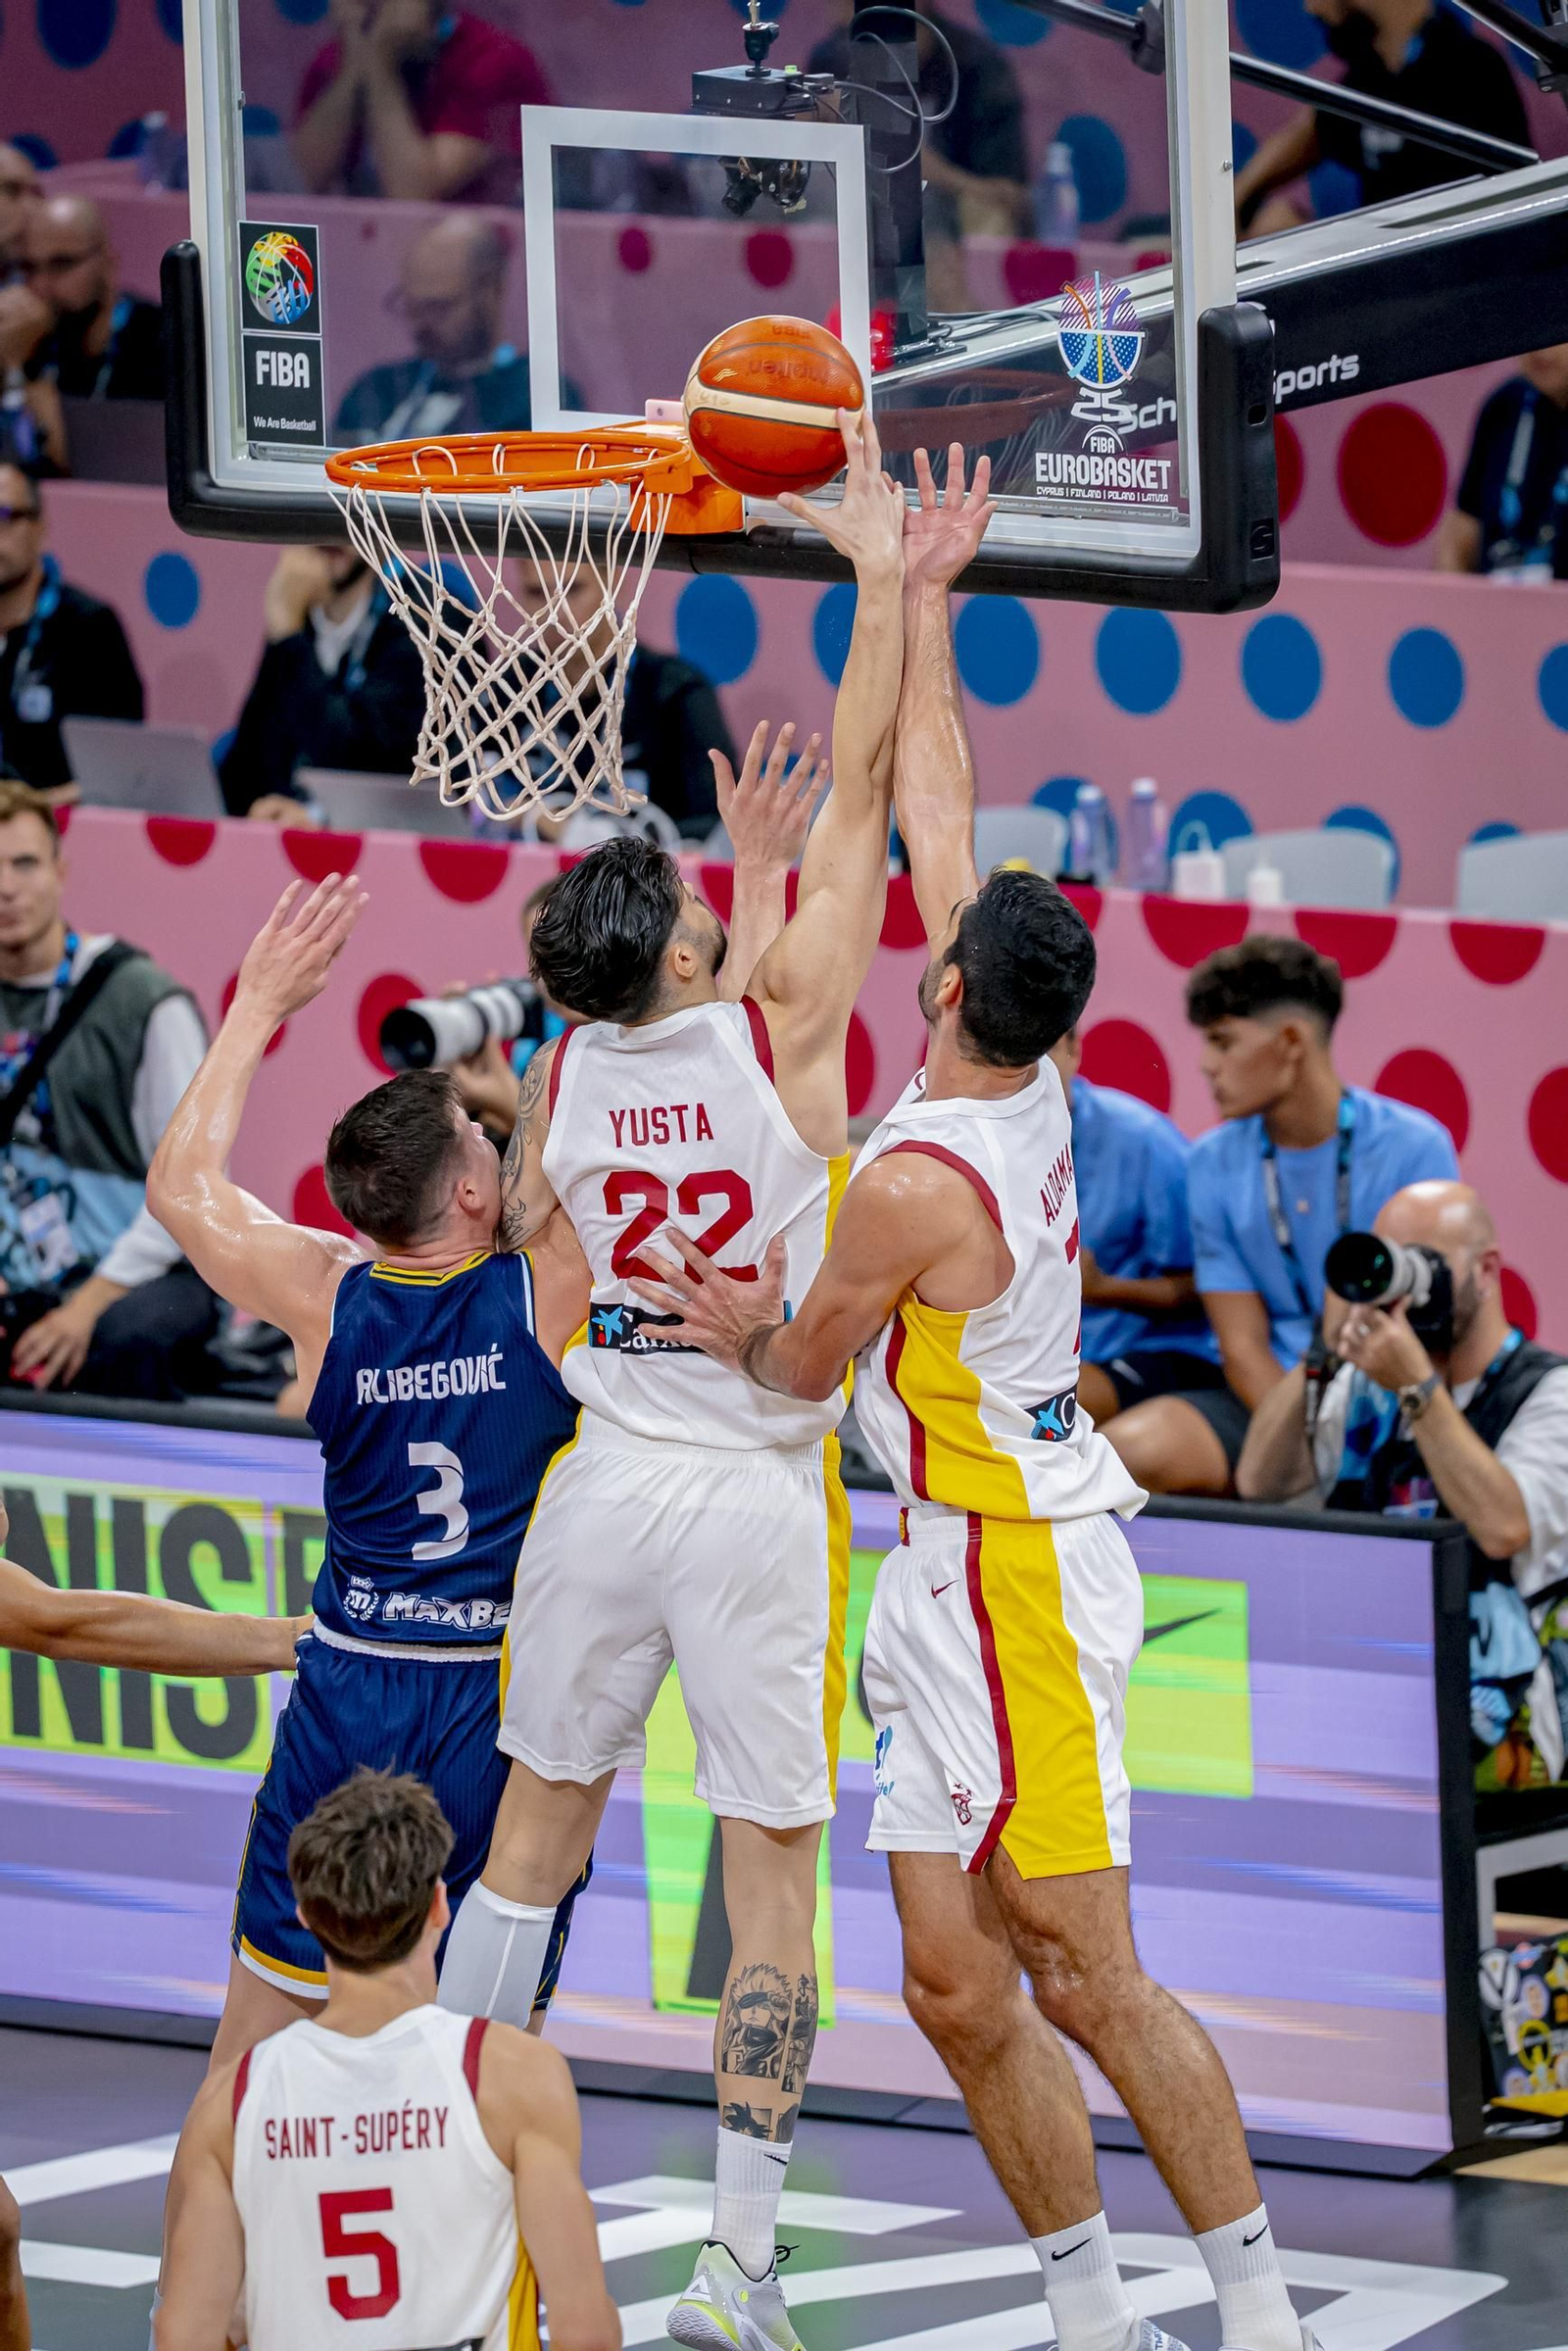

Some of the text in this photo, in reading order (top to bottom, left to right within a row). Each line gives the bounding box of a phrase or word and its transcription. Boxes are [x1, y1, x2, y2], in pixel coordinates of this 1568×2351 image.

[256, 350, 310, 388] FIBA
[1273, 355, 1359, 404] ports
[254, 416, 317, 431] We Are Basketball
[1091, 436, 1115, 454] FIBA
[1035, 453, 1171, 489] EUROBASKET
[1036, 486, 1169, 503] CYPRUS FINLAND POLAND LATVIA
[609, 1102, 714, 1149] YUSTA
[1040, 1143, 1073, 1227] ALDAMA
[603, 1169, 760, 1285] 22
[356, 1344, 507, 1405] ALIBEGOVIĆ
[408, 1442, 469, 1560] 3
[265, 2099, 449, 2160] SAINT-SUPÉRY
[318, 2186, 401, 2321] 5
